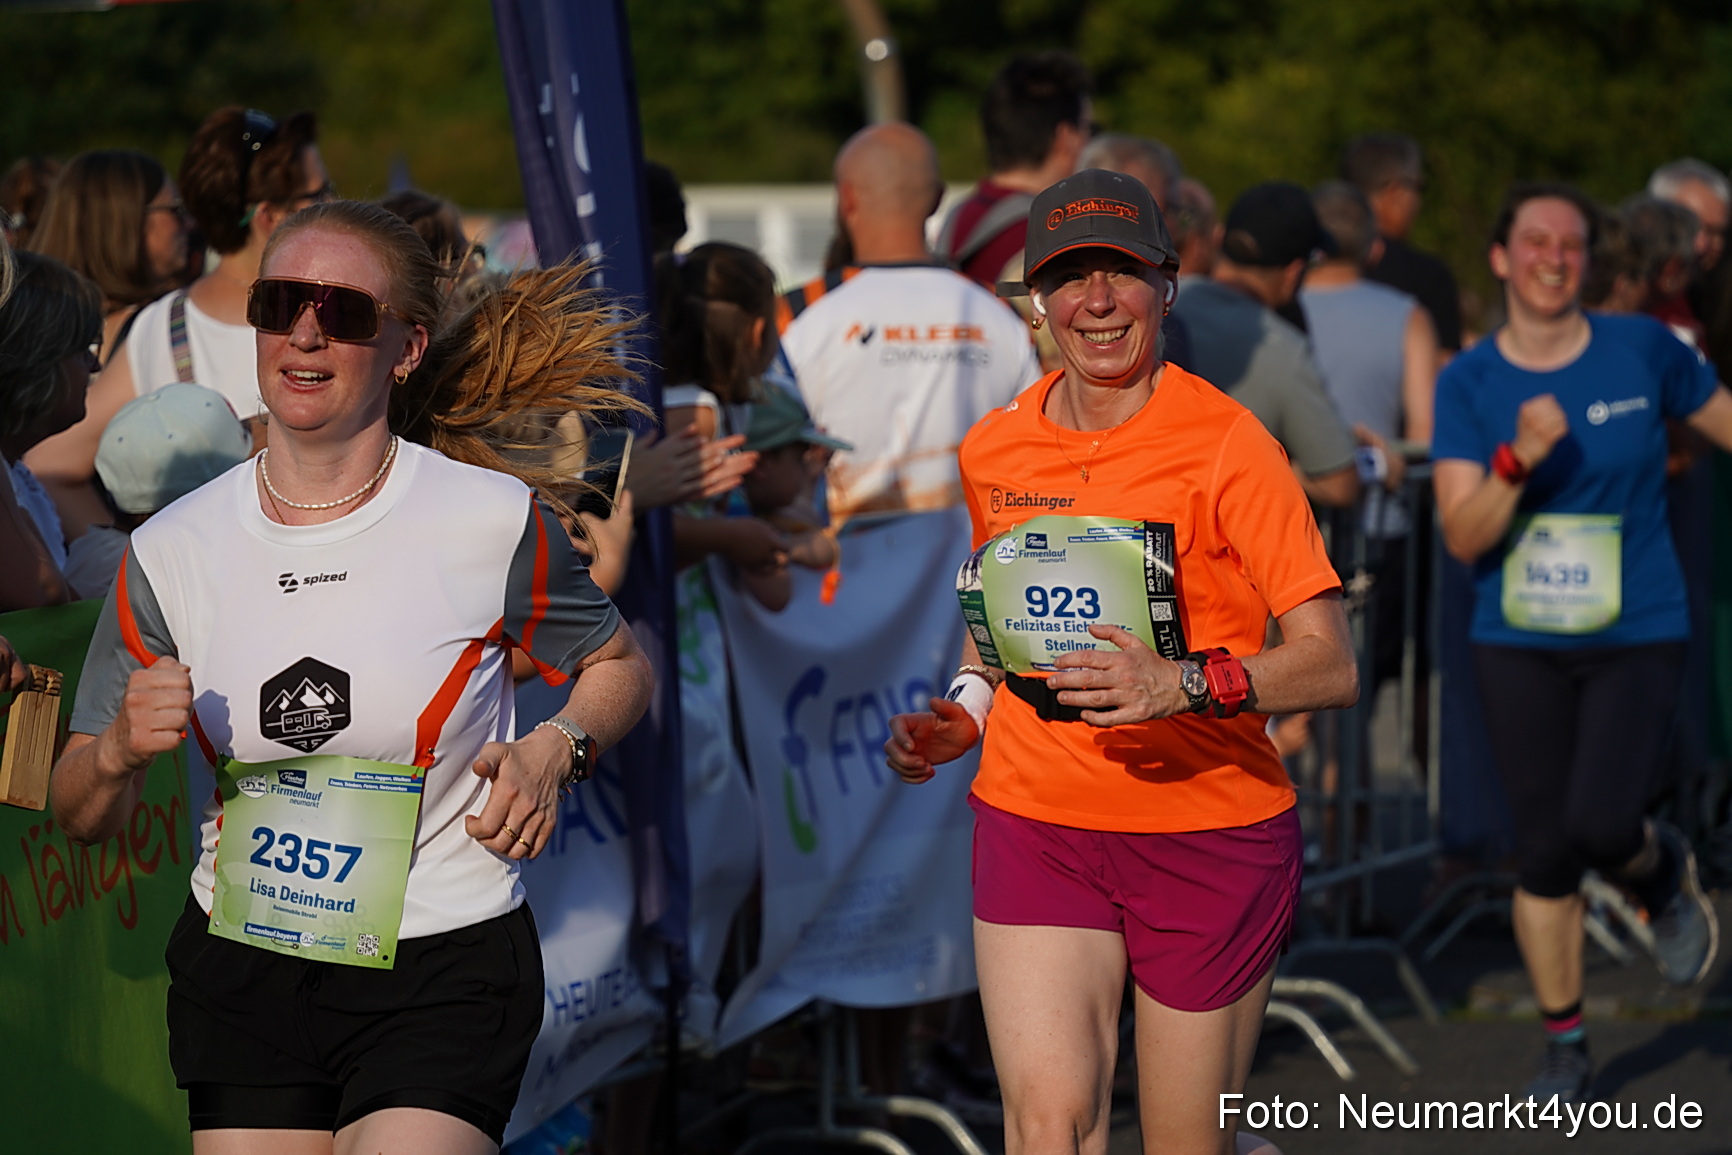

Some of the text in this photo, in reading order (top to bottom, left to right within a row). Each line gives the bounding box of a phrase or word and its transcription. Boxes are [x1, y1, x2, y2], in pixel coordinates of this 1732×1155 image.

[1065, 199, 1140, 220] Eichinger
[1004, 492, 1076, 510] Eichinger
[1019, 548, 1067, 559] Firmenlauf
[1145, 530, 1156, 593] 20 % RABATT
[302, 571, 348, 587] spized
[1155, 559, 1163, 593] FACTOR
[1025, 586, 1101, 619] 923
[1005, 618, 1061, 632] Felizitas
[1045, 638, 1097, 652] Stellner
[1159, 624, 1177, 661] HILTL
[270, 784, 323, 801] Firmenlauf
[289, 798, 320, 808] neumarkt
[250, 826, 363, 884] 2357
[249, 877, 356, 914] Lisa Deinhard
[300, 911, 318, 919] Strobl
[246, 925, 298, 941] firmenlauf.bayern
